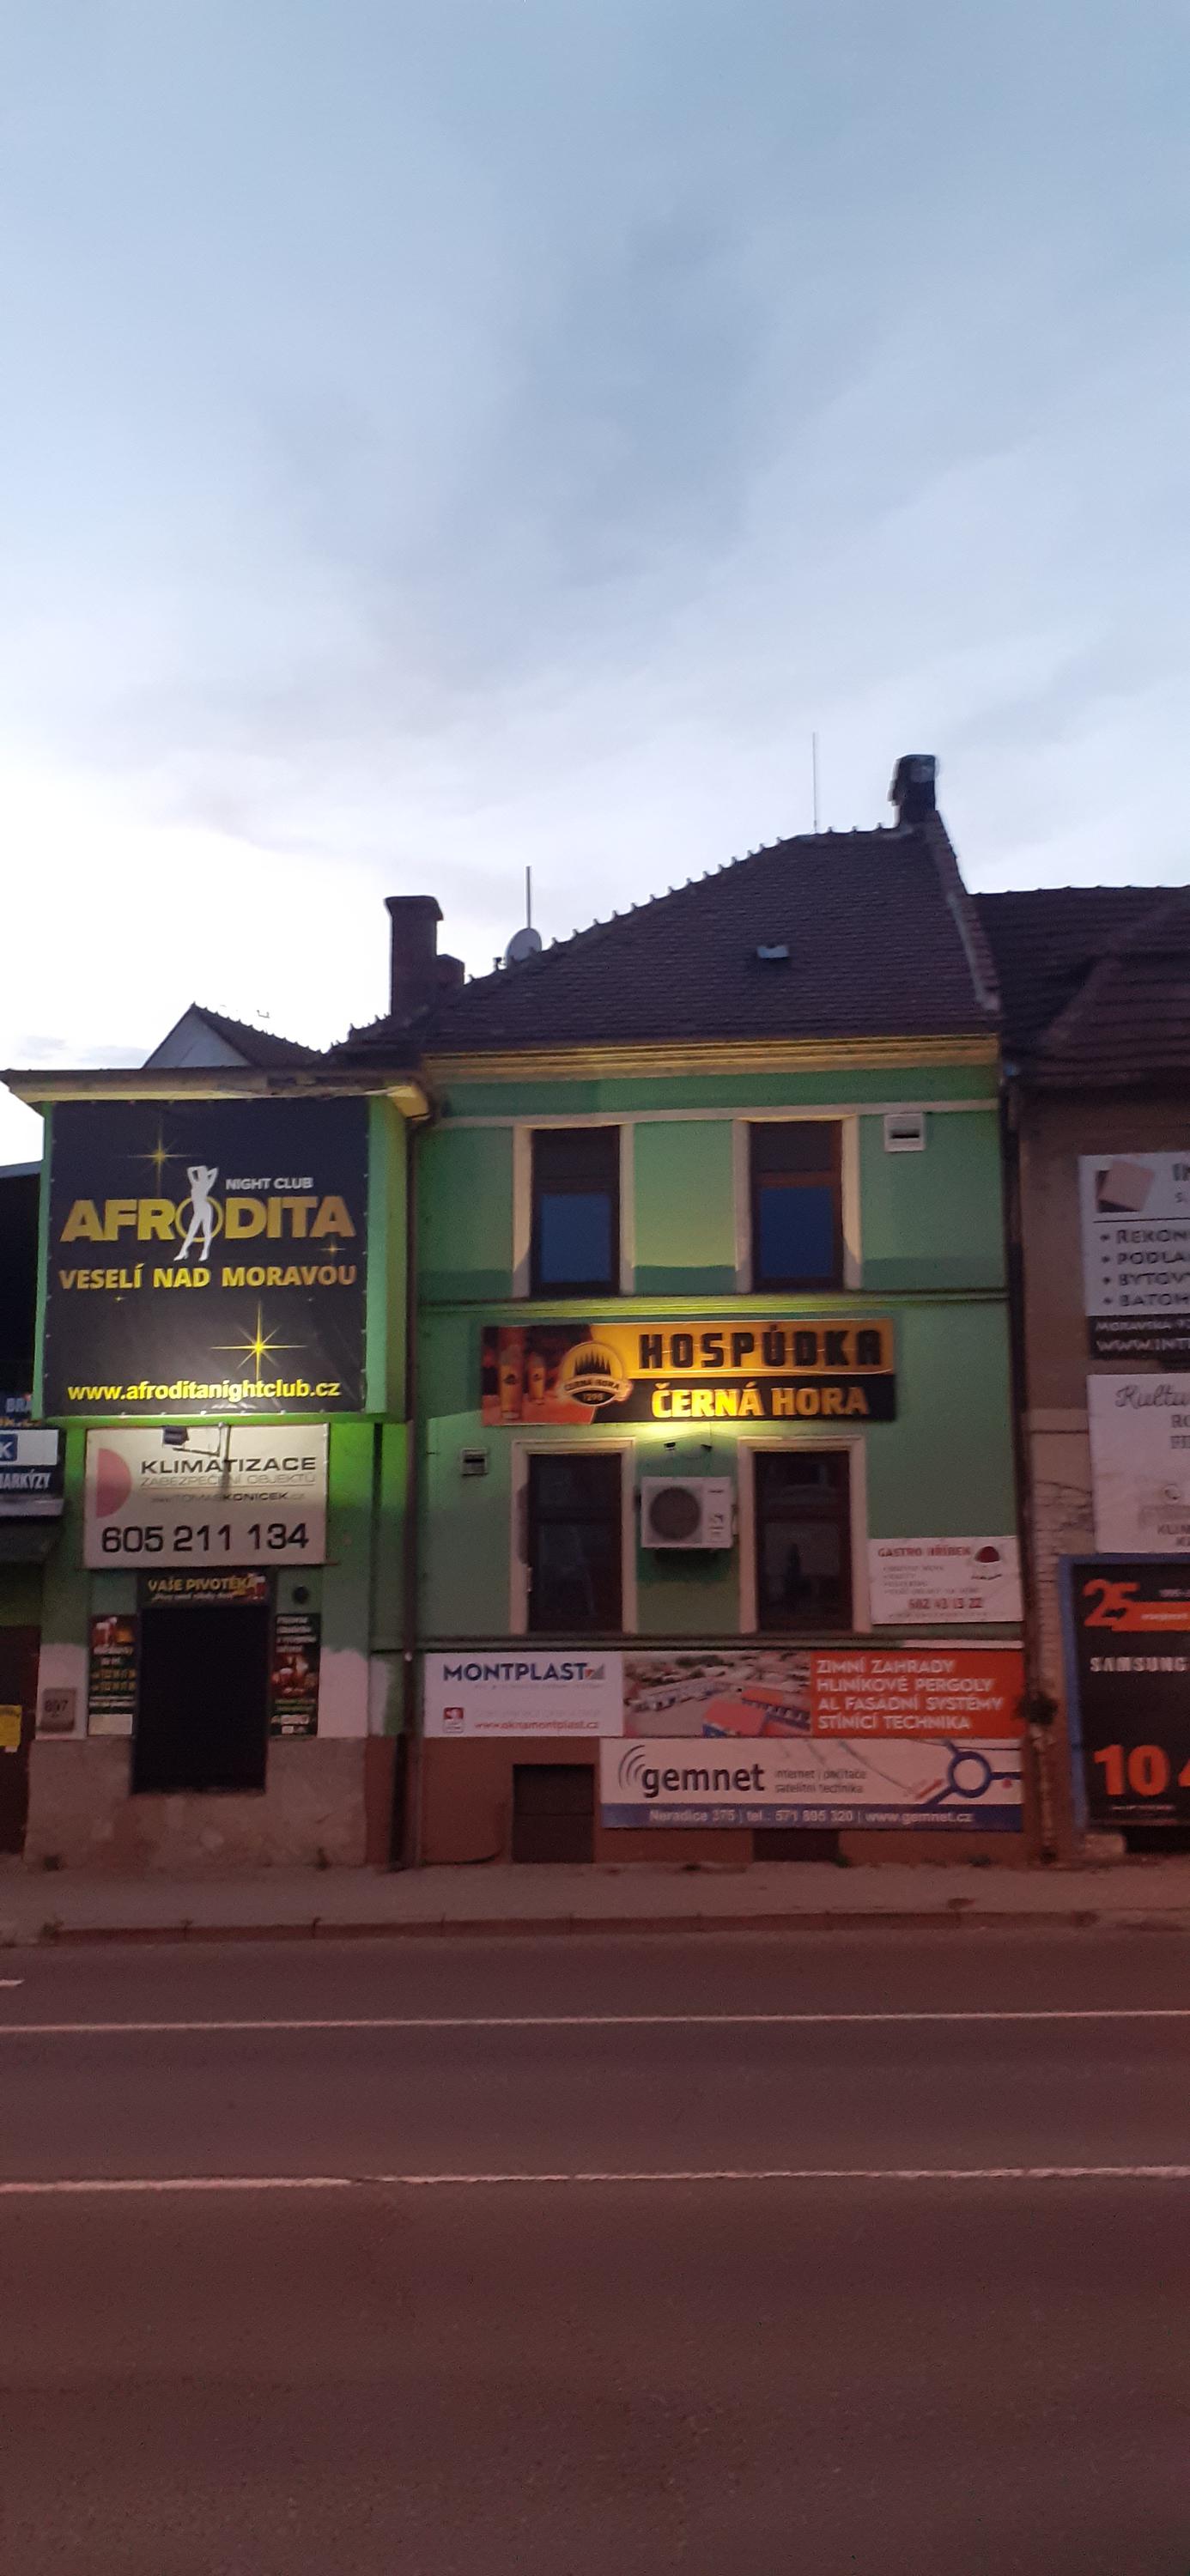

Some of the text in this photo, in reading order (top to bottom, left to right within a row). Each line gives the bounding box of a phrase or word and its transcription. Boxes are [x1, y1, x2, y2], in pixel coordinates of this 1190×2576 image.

[225, 1177, 314, 1190] NIGHT CLUB
[59, 1196, 356, 1242] AFRODITA
[58, 1262, 357, 1289] VESELÍ NAD MORAVOU
[67, 1378, 341, 1402] www.afroditanightclub.cz
[651, 1381, 870, 1419] ČERNÁ HORA
[142, 1457, 316, 1474] KLIMATIZACE
[101, 1522, 309, 1553] 605 211 134
[877, 1547, 922, 1557] GASTRO
[443, 1662, 587, 1680] MONTPLAST
[817, 1656, 956, 1674] ZIMNÍ ZAHRADY
[1089, 1656, 1189, 1673] SAMSUNG
[817, 1676, 997, 1692] HLINÍKOVÉ PERGOLY
[817, 1693, 1005, 1710] AL FASÁDNÍ SYSTÉMY
[817, 1712, 972, 1729] STÍNÍCÍ TECHNIKA
[1093, 1743, 1171, 1797] 10
[641, 1763, 765, 1798] gemnet
